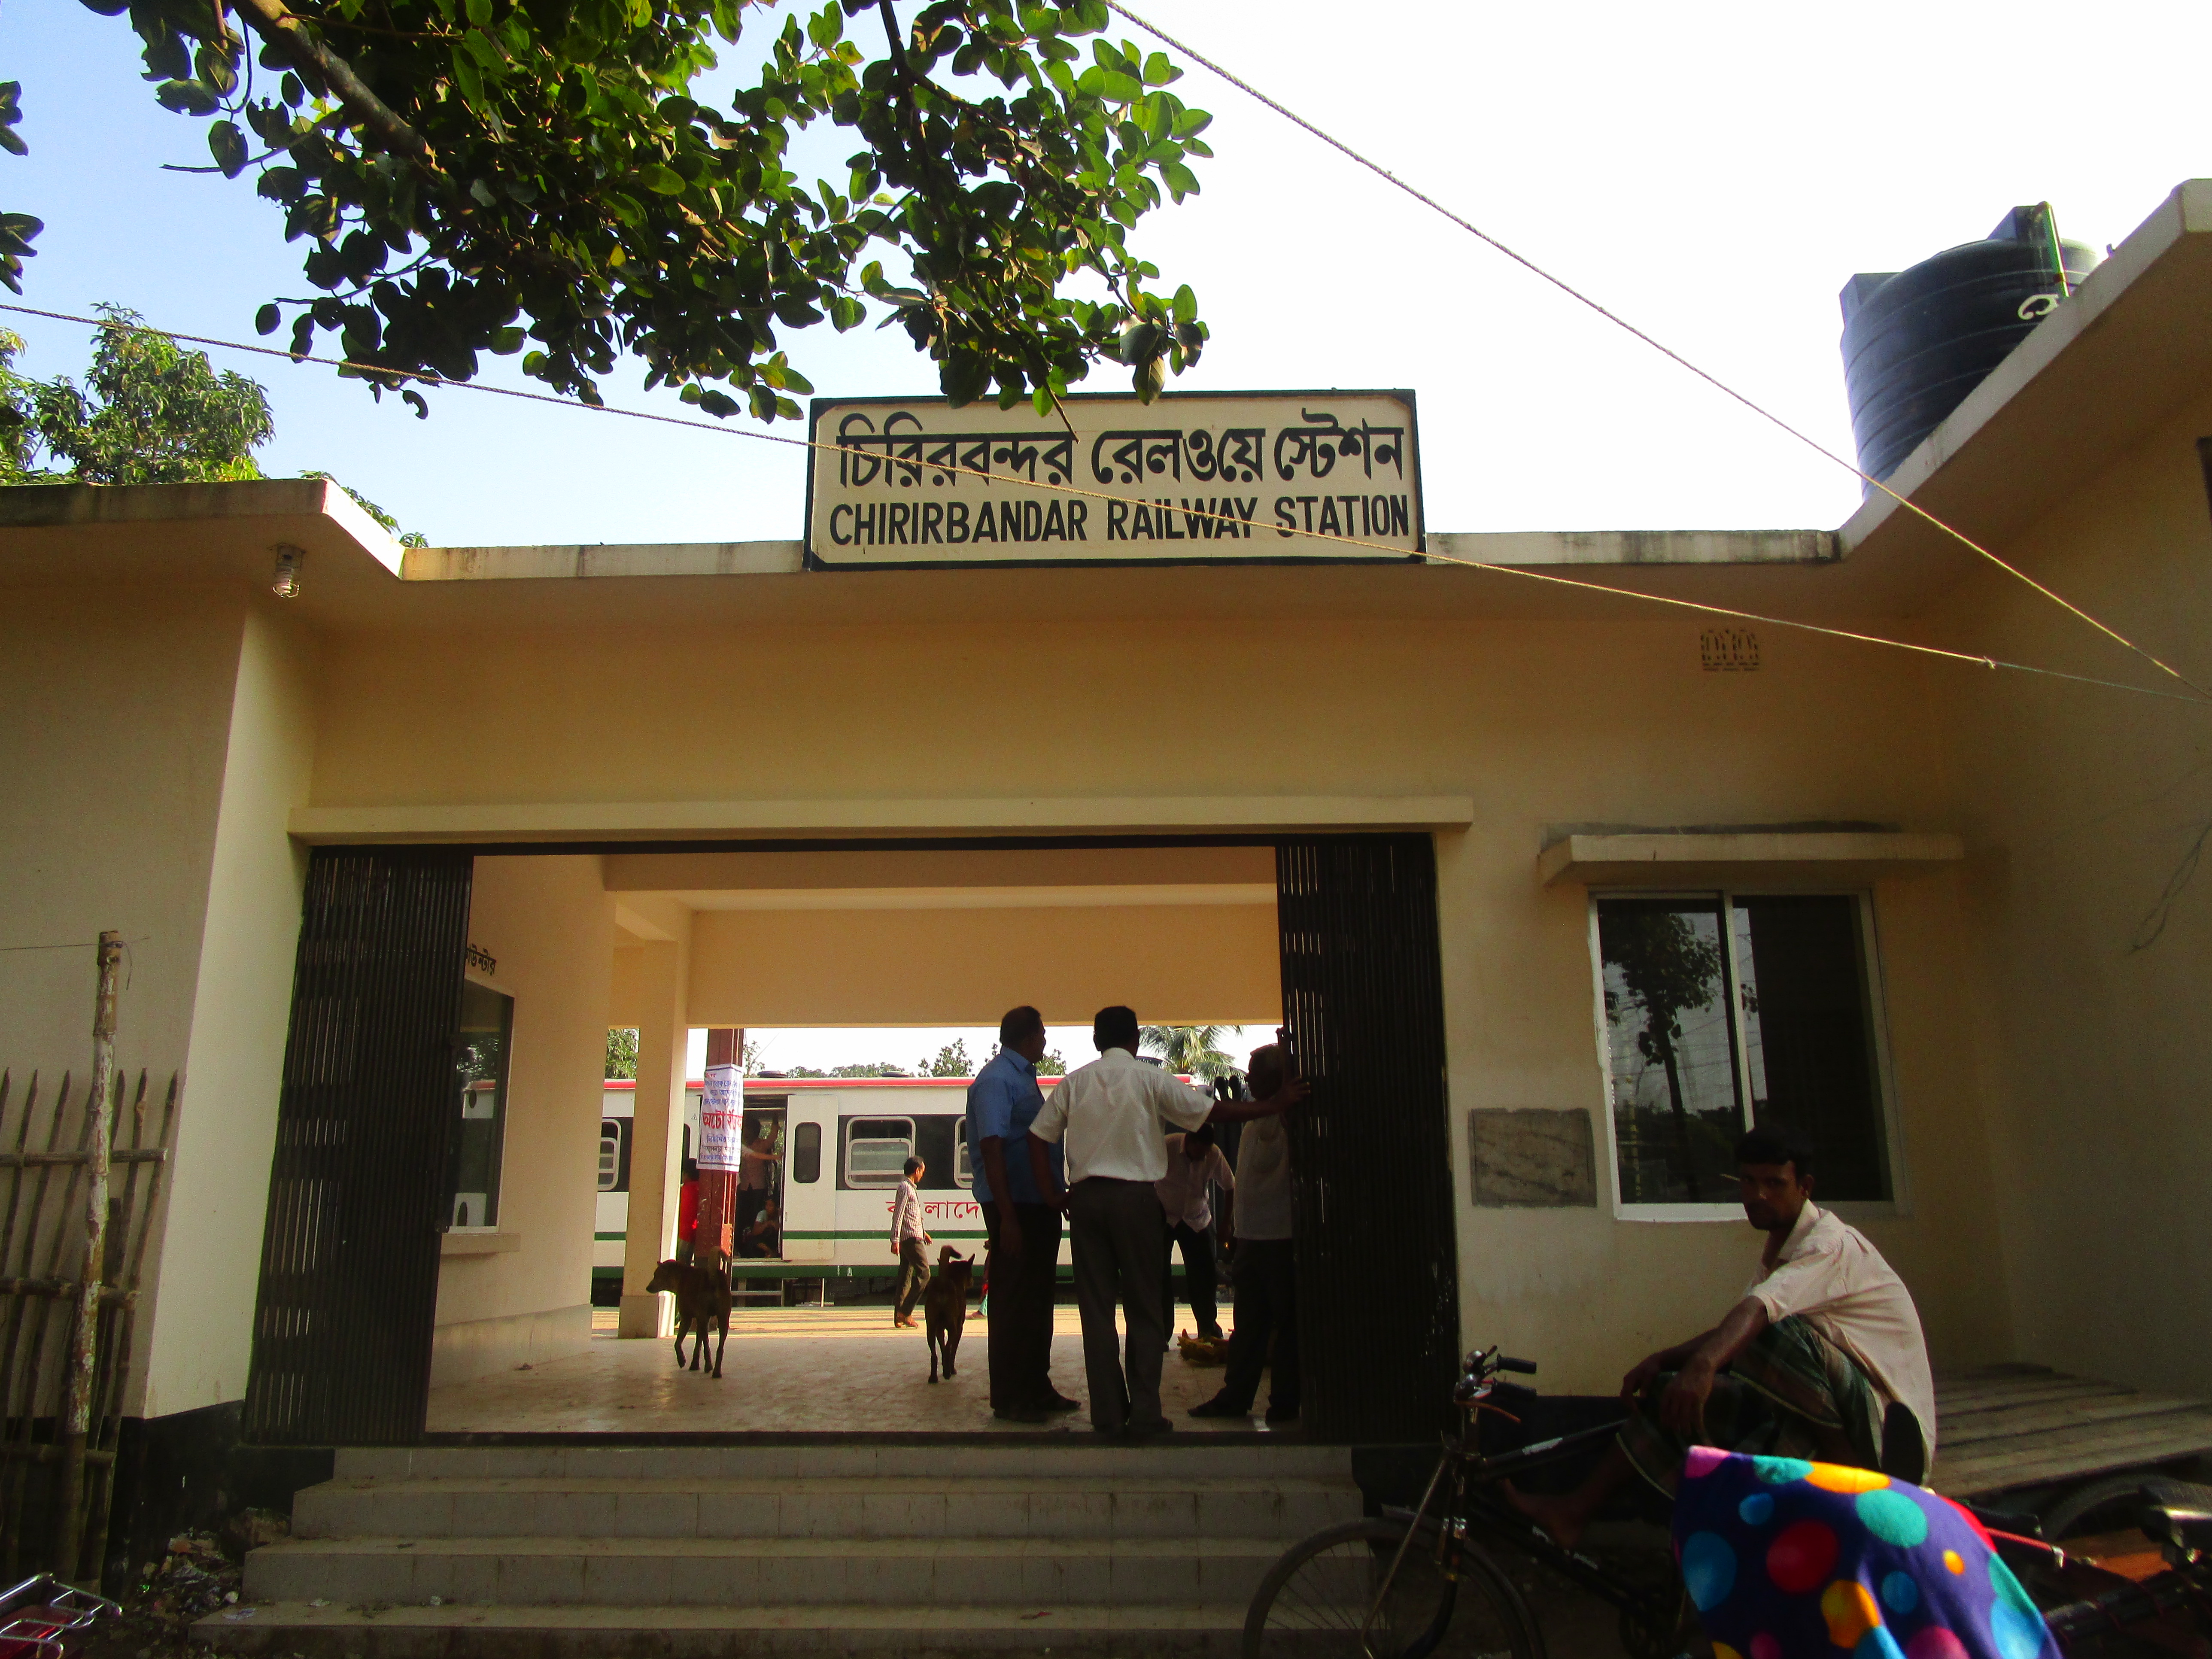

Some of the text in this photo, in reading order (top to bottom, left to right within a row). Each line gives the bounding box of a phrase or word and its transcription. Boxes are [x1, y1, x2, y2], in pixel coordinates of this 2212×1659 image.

[836, 407, 1404, 487] চিরিরবন্দর রেলওয়ে স্টেশন
[830, 495, 1409, 545] CHIRIRBANDAR RAILWAY STATION
[703, 1109, 724, 1129] অটো
